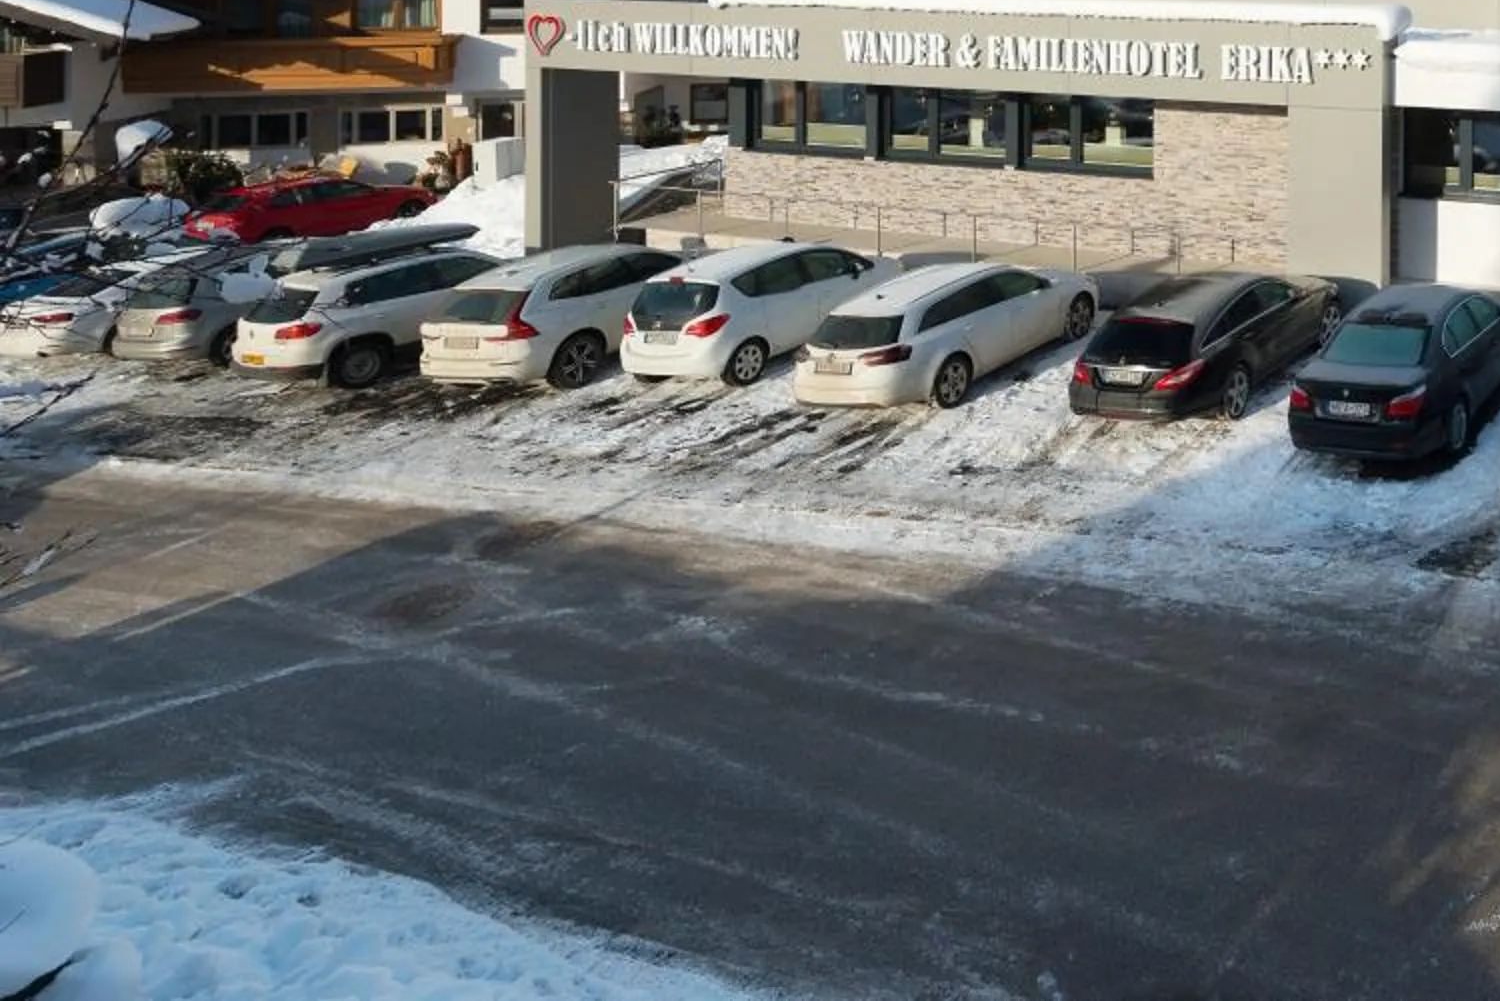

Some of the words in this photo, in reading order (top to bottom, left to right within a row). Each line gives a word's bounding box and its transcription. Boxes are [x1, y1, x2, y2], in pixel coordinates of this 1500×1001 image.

[634, 22, 799, 60] WILLKOMMEN!
[842, 30, 948, 66] WANDER
[956, 33, 981, 67] &
[987, 36, 1202, 79] FAMILIENHOTEL
[1220, 44, 1313, 83] ERIKA
